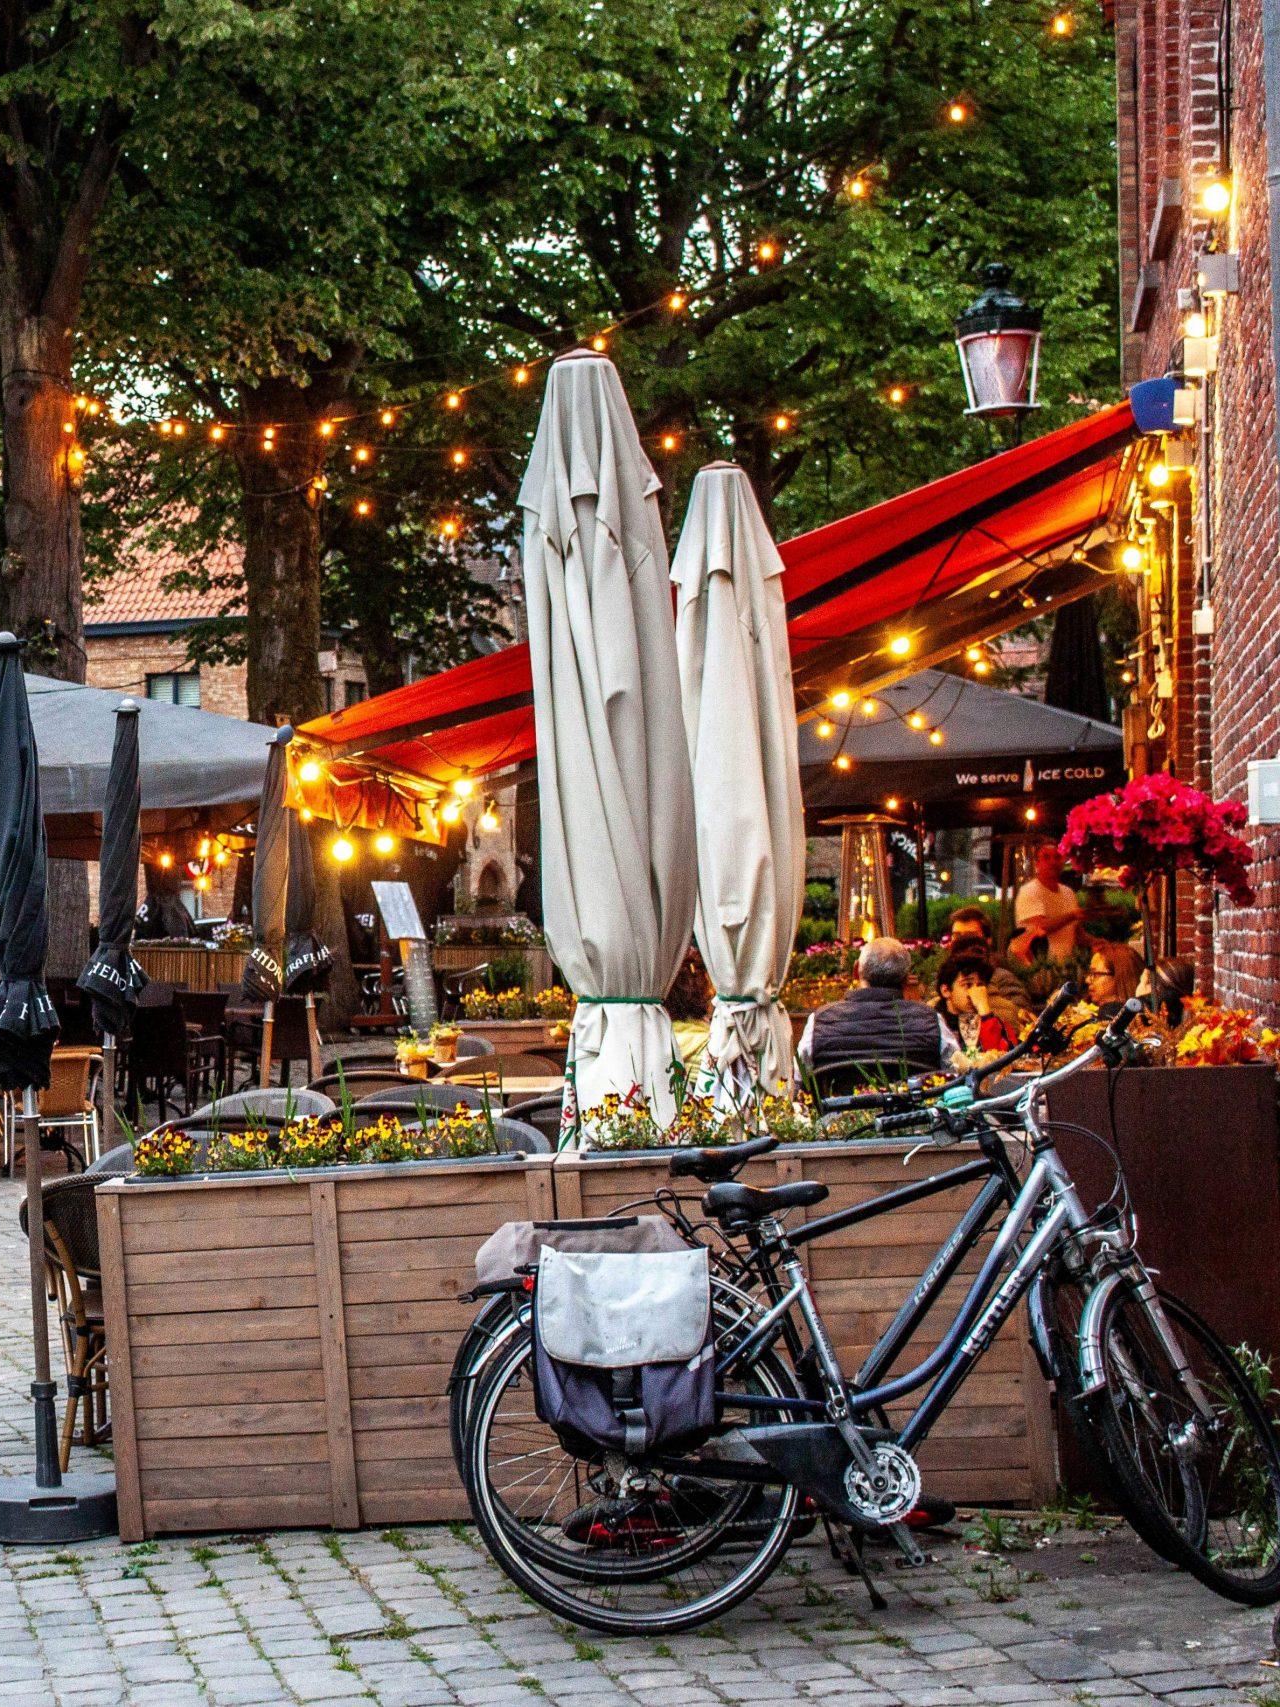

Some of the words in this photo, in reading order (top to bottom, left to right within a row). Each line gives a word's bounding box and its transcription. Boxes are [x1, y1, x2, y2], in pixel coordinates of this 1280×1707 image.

[956, 773, 979, 785] We
[981, 773, 1019, 784] serve
[1038, 769, 1061, 781] ICE
[1064, 767, 1105, 779] COLD
[913, 1232, 963, 1305] KROSS
[960, 1269, 1026, 1356] KETTLER
